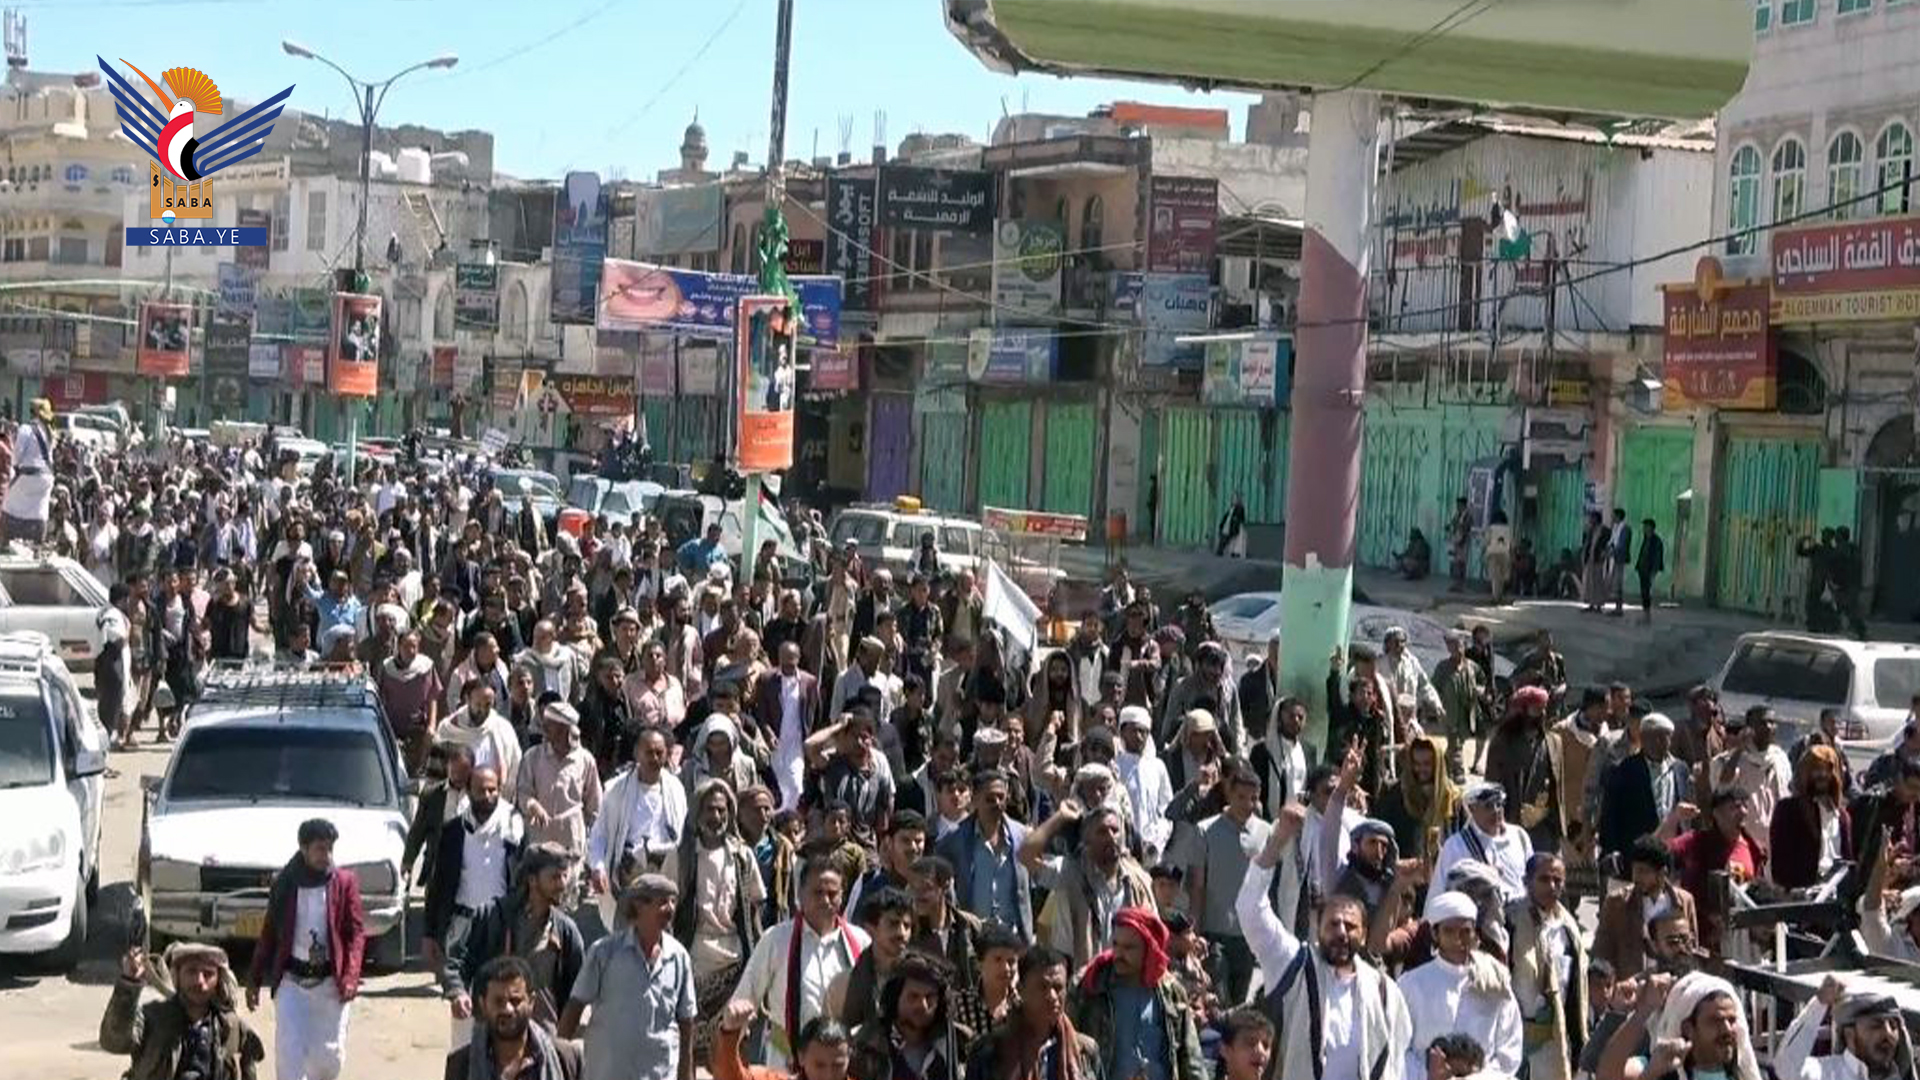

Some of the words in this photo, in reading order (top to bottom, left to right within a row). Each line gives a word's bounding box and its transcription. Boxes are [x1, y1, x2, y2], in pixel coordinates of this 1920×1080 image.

[941, 190, 985, 208] الوليد
[856, 193, 871, 295] YEMENSOFT
[1776, 235, 1839, 285] السياحي
[1669, 301, 1718, 341] الشارقة
[1846, 294, 1893, 314] TOURIST
[1720, 309, 1762, 342] مجمع
